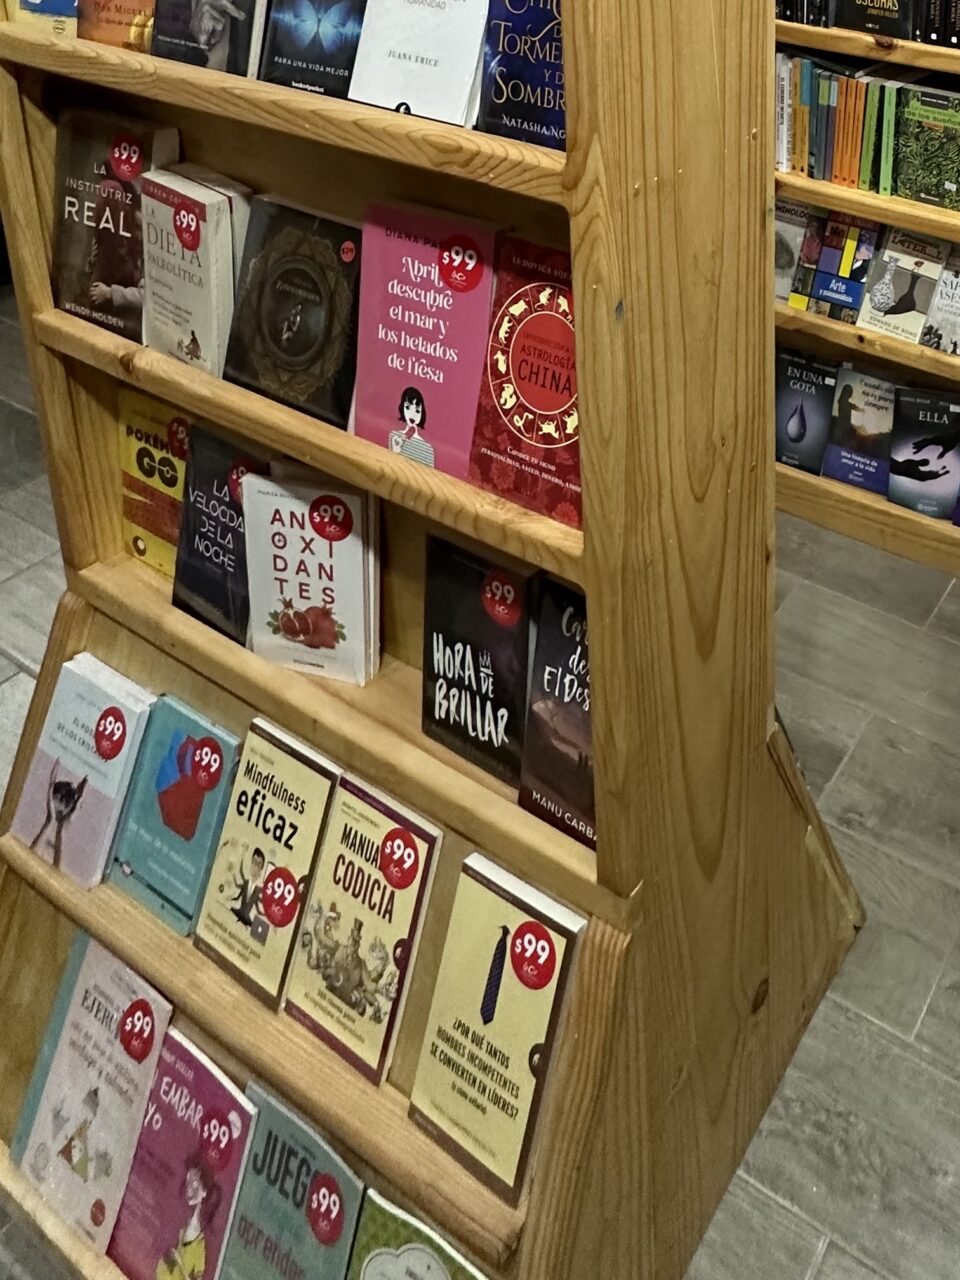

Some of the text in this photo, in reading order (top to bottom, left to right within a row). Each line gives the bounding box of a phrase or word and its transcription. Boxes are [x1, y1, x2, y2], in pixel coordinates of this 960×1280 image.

[274, 56, 349, 77] PARA VIDA MEJOR
[387, 49, 440, 67] JUANA ERICE
[503, 114, 550, 135] NATASHA
[113, 142, 139, 163] $99
[94, 163, 107, 176] LA
[66, 178, 133, 205] INSTITUTRIZ
[64, 196, 132, 238] REAL
[175, 209, 197, 232] $99
[385, 227, 418, 246] DIANA
[442, 245, 477, 272] $99
[388, 278, 454, 313] descubre
[829, 279, 846, 293] Arte
[64, 302, 124, 329] WENDY HOLDEN
[389, 305, 437, 331] el mar
[377, 324, 459, 363] los helados
[387, 351, 405, 372] de
[517, 359, 574, 398] CHINA
[787, 367, 823, 385] EN UNA
[790, 380, 816, 395] GOTA
[918, 410, 949, 425] ELLA
[214, 479, 230, 502] LA
[312, 504, 345, 523] $99
[217, 526, 234, 548] LA
[195, 535, 235, 572] NOCHE
[485, 580, 515, 605] $99
[433, 632, 477, 691] HORA
[480, 671, 494, 698] DE
[434, 678, 510, 748] BRILLAR
[99, 716, 123, 741] $99
[194, 747, 220, 772] $99
[243, 759, 306, 815] Mindfulness
[532, 789, 562, 817] MANU
[236, 789, 299, 851] eficaz
[385, 838, 416, 868] $99
[266, 877, 296, 906] $99
[333, 855, 397, 924] CODICIA
[515, 934, 552, 965] $99
[125, 1011, 152, 1038] $99
[437, 1025, 520, 1099] HOMBRES INCOMPETENTES
[471, 1030, 485, 1049] QUÉ
[486, 1040, 510, 1070] TANTOS
[430, 1041, 519, 1120] SE CONVIERTEN LÍDERES?
[203, 1119, 229, 1149] $99
[312, 1187, 341, 1219] $99
